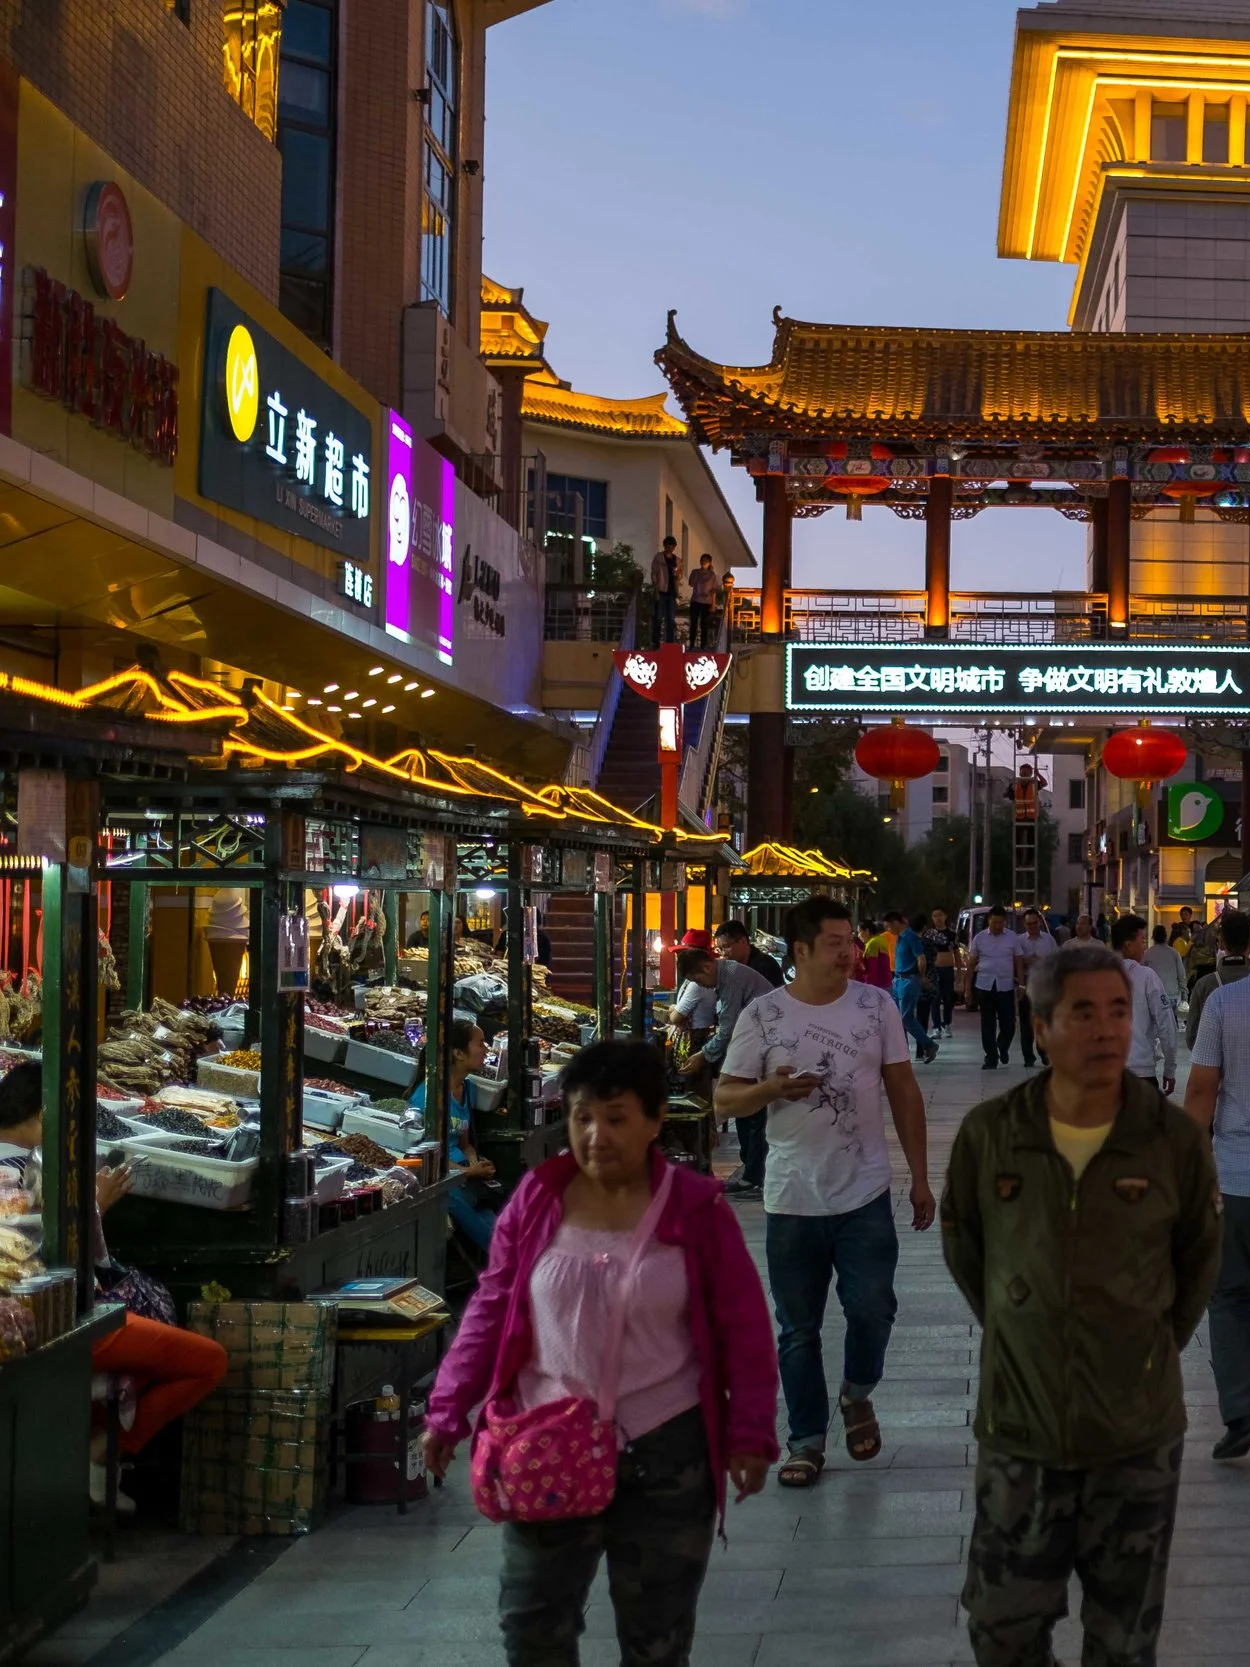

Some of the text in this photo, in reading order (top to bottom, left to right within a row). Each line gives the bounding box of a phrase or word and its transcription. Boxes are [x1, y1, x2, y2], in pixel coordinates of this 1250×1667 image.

[265, 390, 370, 519] 立新超市
[298, 498, 342, 539] SUPERMARKET
[804, 664, 1243, 695] 创建全国文明城市 争做文明有礼敦煌人
